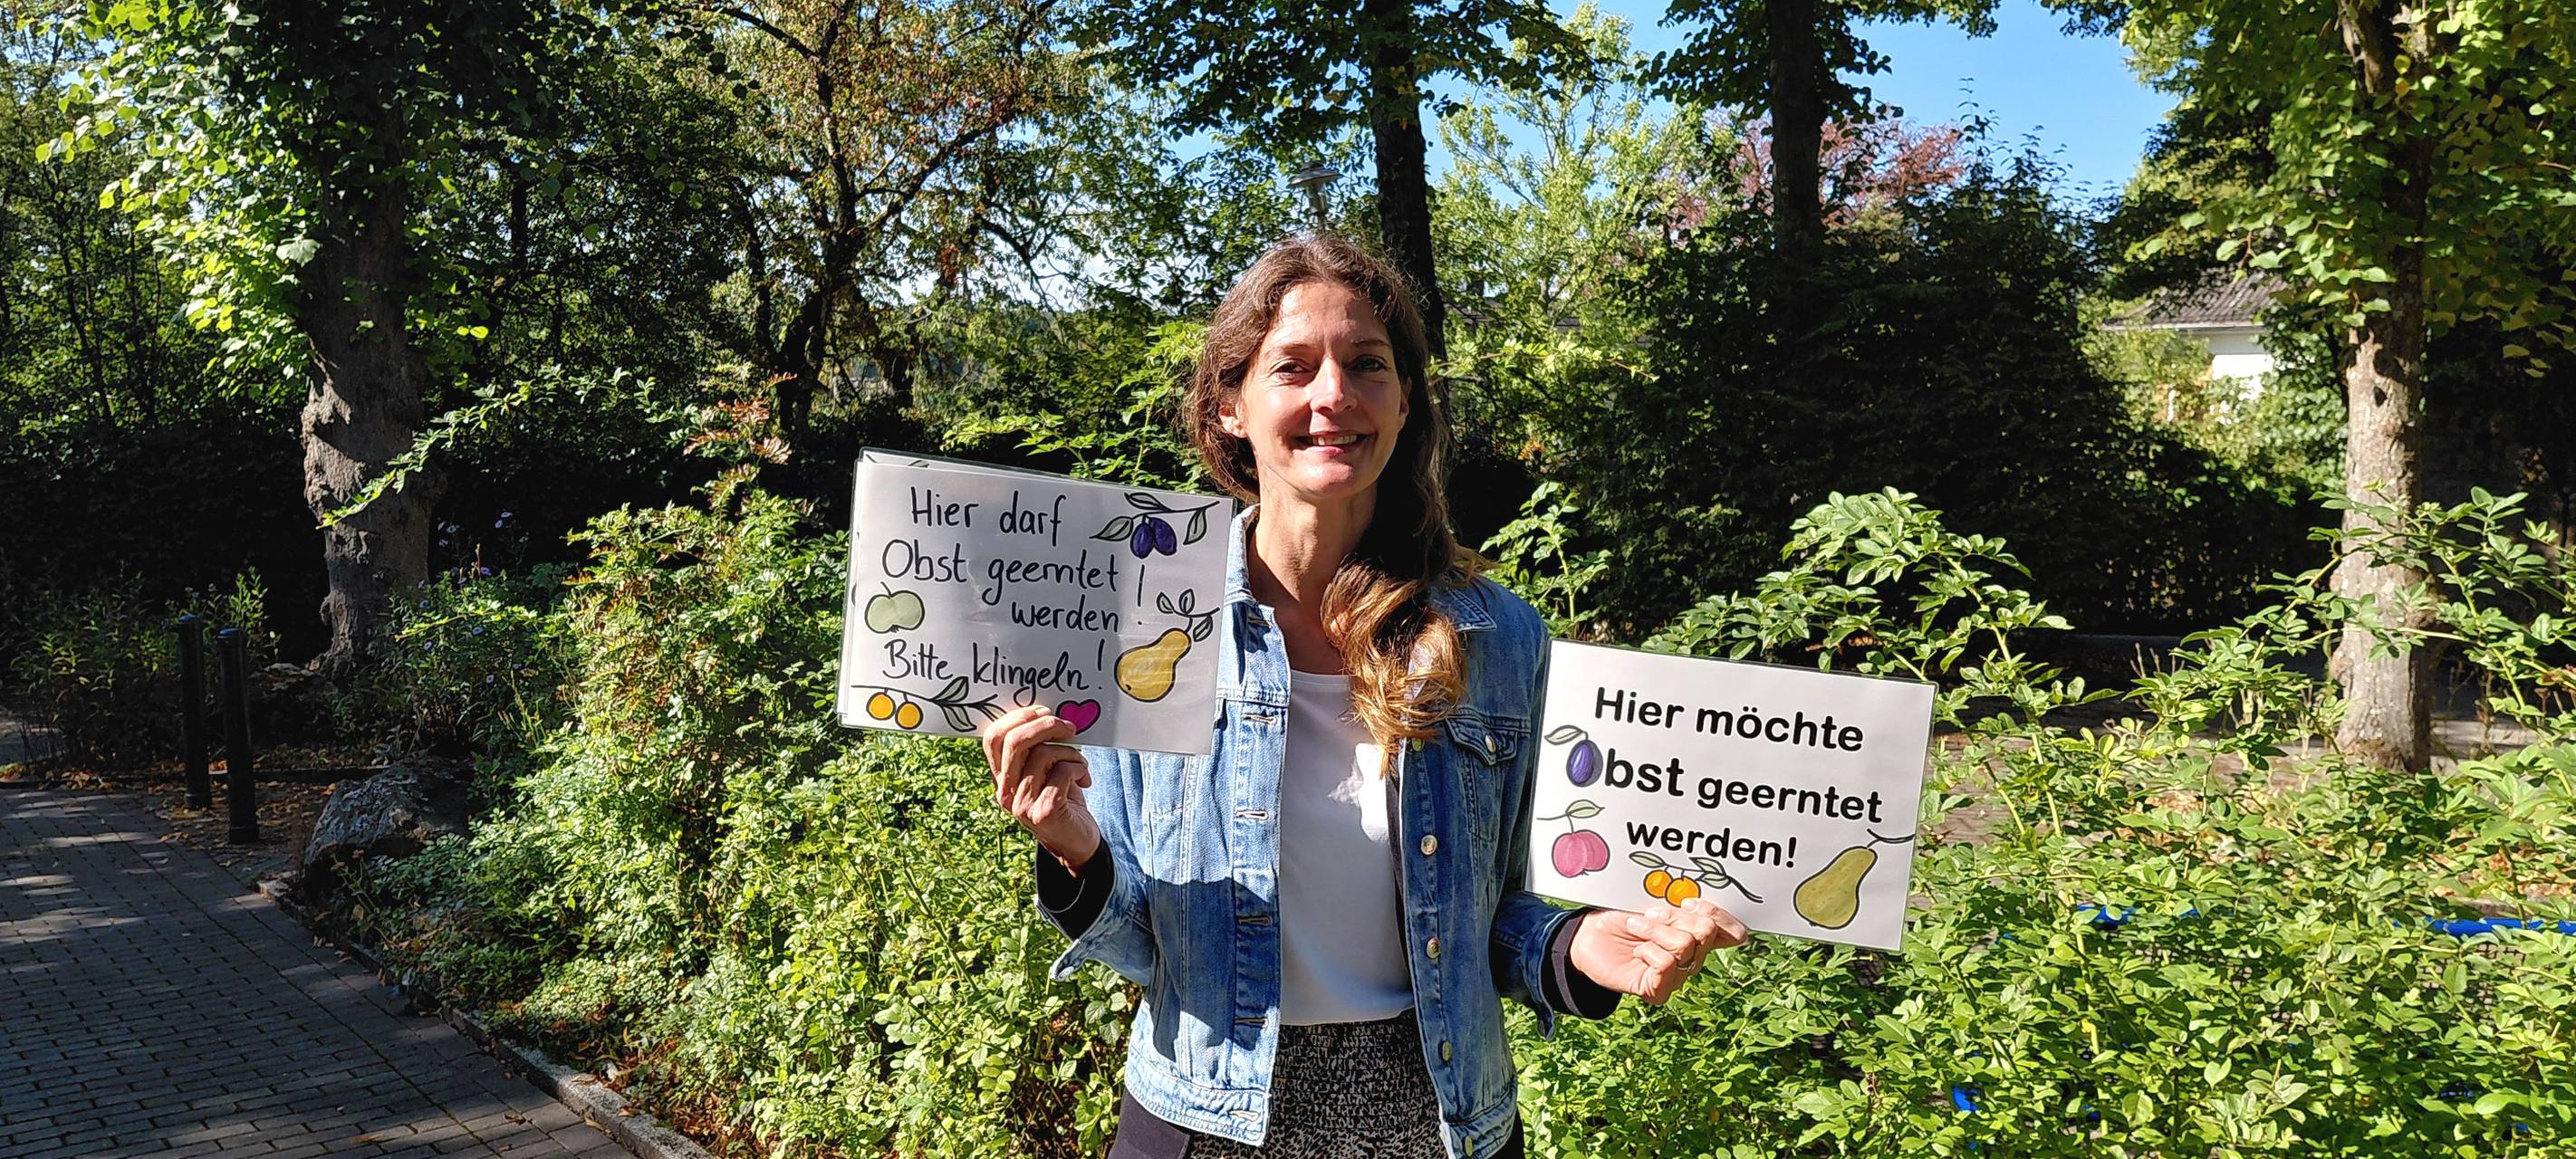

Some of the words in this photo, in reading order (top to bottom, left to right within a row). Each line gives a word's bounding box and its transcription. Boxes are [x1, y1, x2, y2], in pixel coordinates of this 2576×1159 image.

[910, 486, 979, 529] Hier
[999, 490, 1067, 547] darf
[881, 539, 967, 583] Obst
[982, 549, 1120, 606] geerntet
[882, 637, 954, 680] Bitte
[972, 638, 1105, 707] klingeln!
[1594, 686, 1685, 729] Hier
[1695, 705, 1864, 752] möchte
[1697, 774, 1883, 825] geerntet
[1626, 820, 1798, 869] werden!
